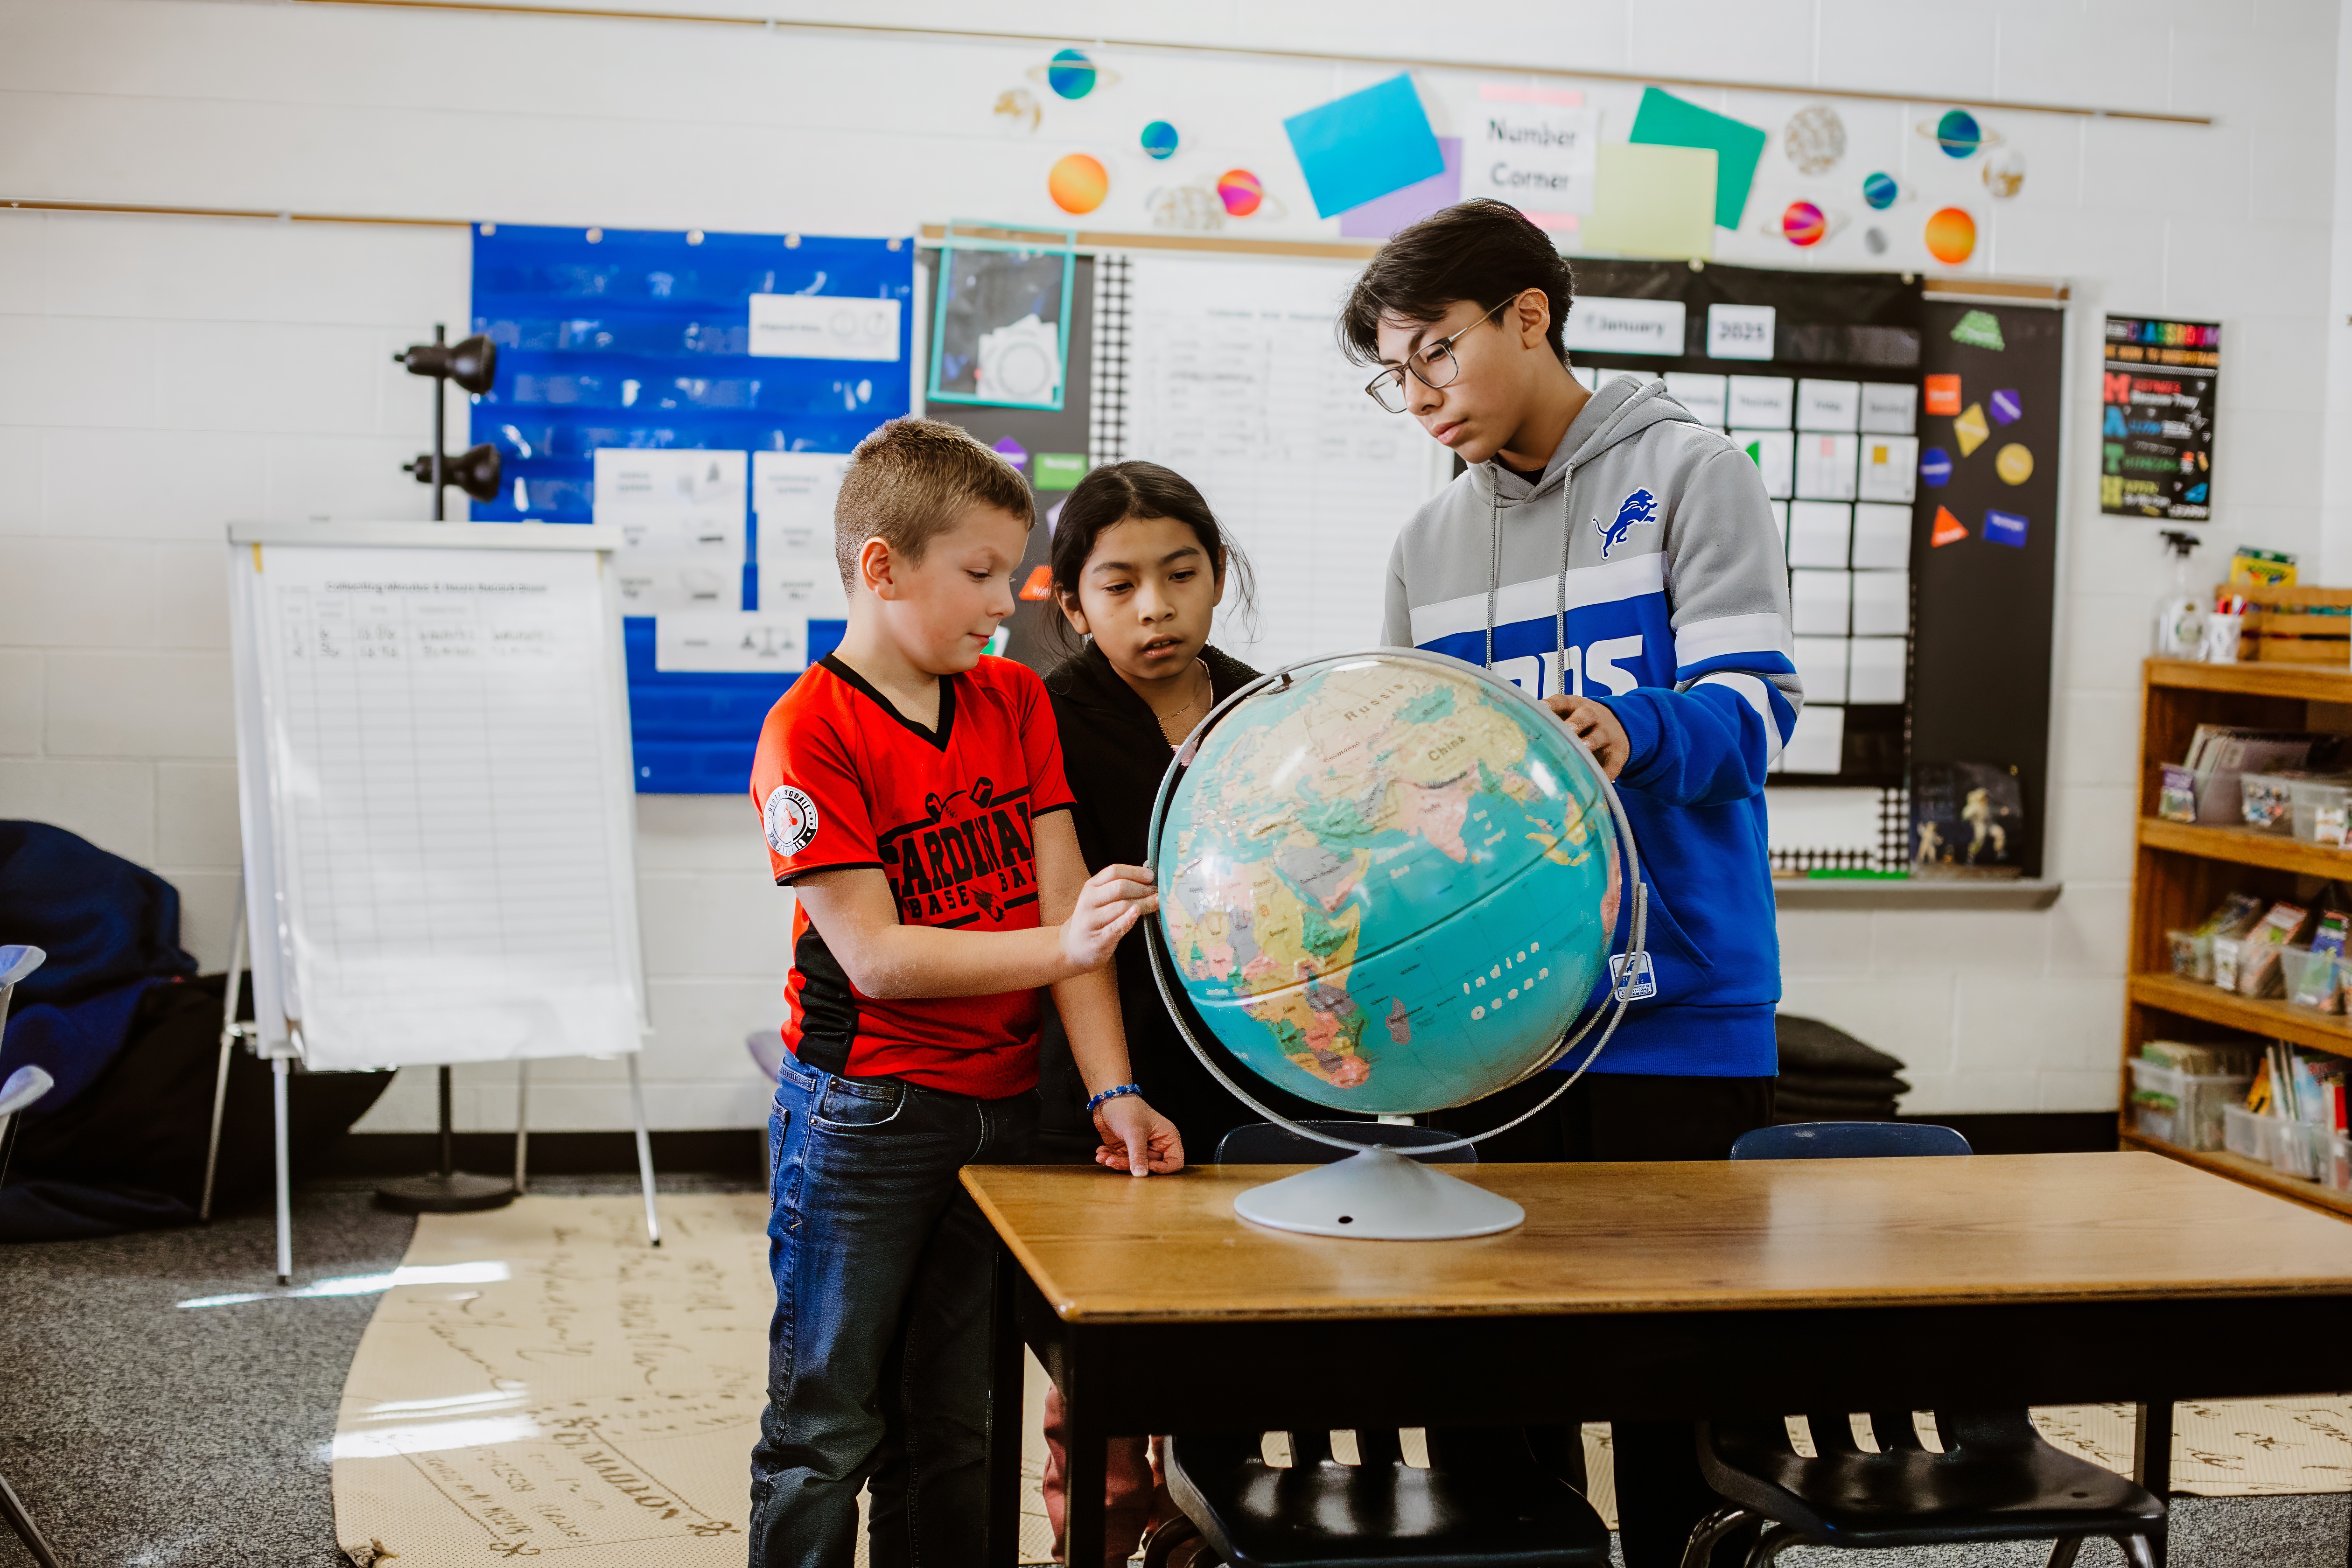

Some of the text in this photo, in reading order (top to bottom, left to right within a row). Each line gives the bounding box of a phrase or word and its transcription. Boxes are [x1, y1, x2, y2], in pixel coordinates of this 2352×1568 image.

[1487, 119, 1577, 148] Number
[1491, 162, 1569, 191] Corner
[1598, 316, 1666, 338] January
[1427, 735, 1466, 762] China
[909, 861, 1036, 918] BASE BAL
[1463, 941, 1540, 995] Indian
[1471, 967, 1549, 1021] Ocean
